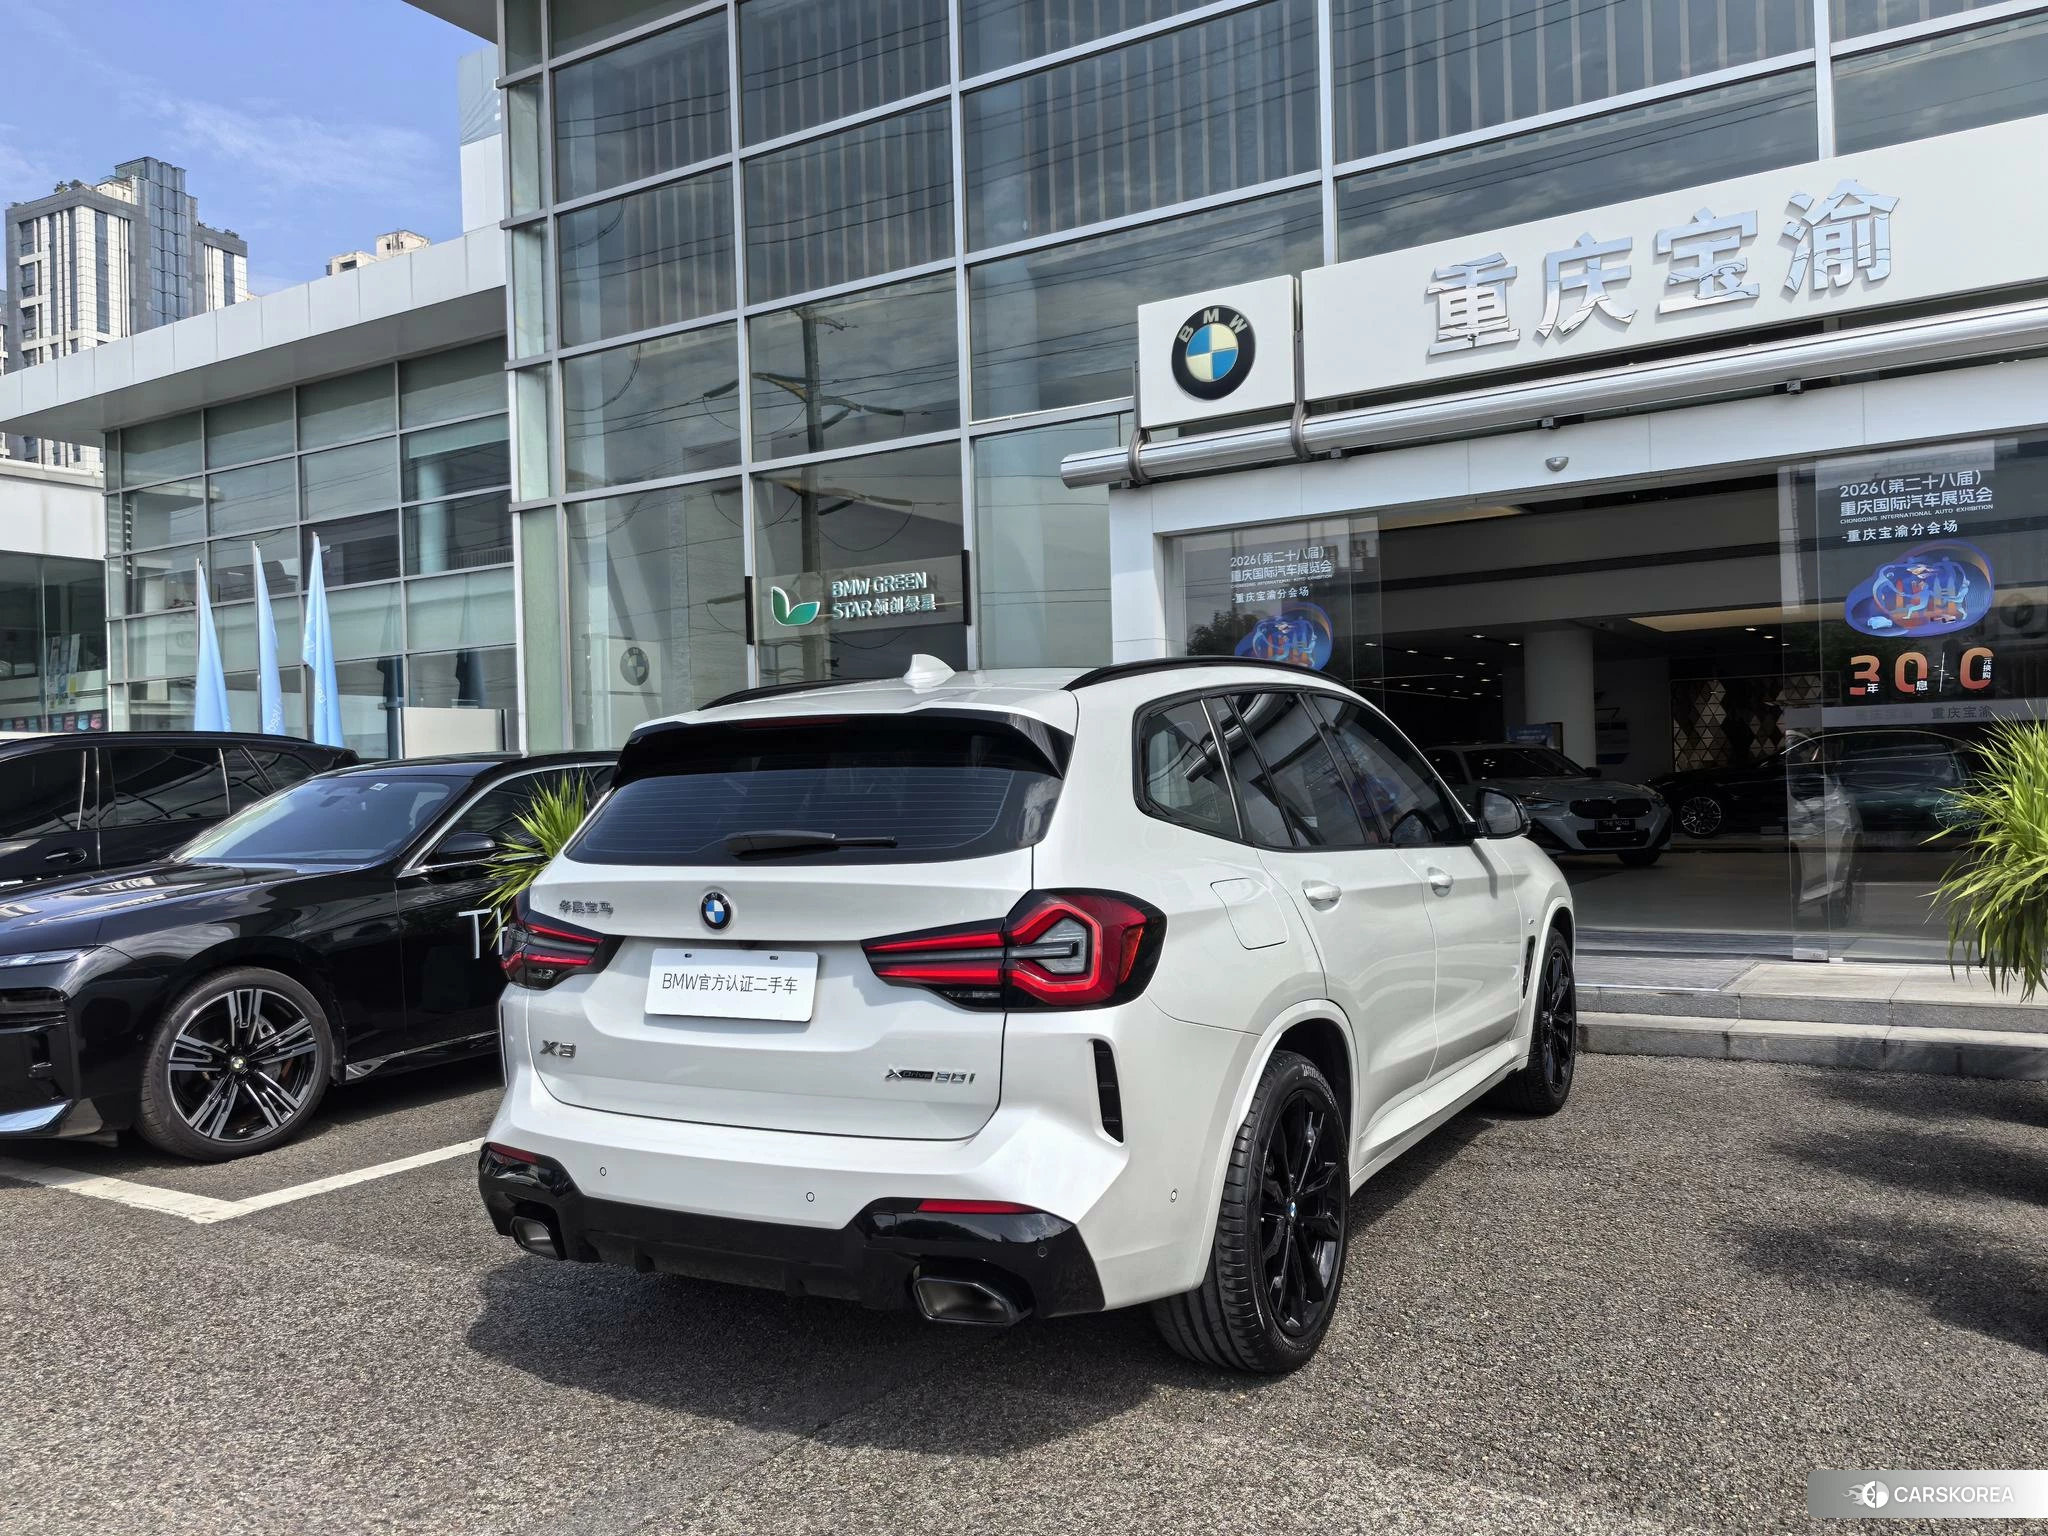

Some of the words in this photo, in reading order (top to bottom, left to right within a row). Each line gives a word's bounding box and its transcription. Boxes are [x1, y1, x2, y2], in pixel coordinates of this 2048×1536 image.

[1426, 178, 1900, 356] 重庆宝渝
[1178, 308, 1248, 343] BMW
[1839, 515, 1878, 525] CHONGQING
[1880, 510, 1932, 521] INTERNATIONAL
[1955, 503, 1994, 513] EXHIBITION
[1840, 486, 1993, 517] 重庆国际汽车展览会
[1231, 560, 1333, 582] 重庆国际汽车展览会
[832, 577, 871, 598] BMW
[873, 571, 928, 594] GREEN
[662, 972, 799, 995] BMW官方认证二手车
[539, 1039, 577, 1059] X3
